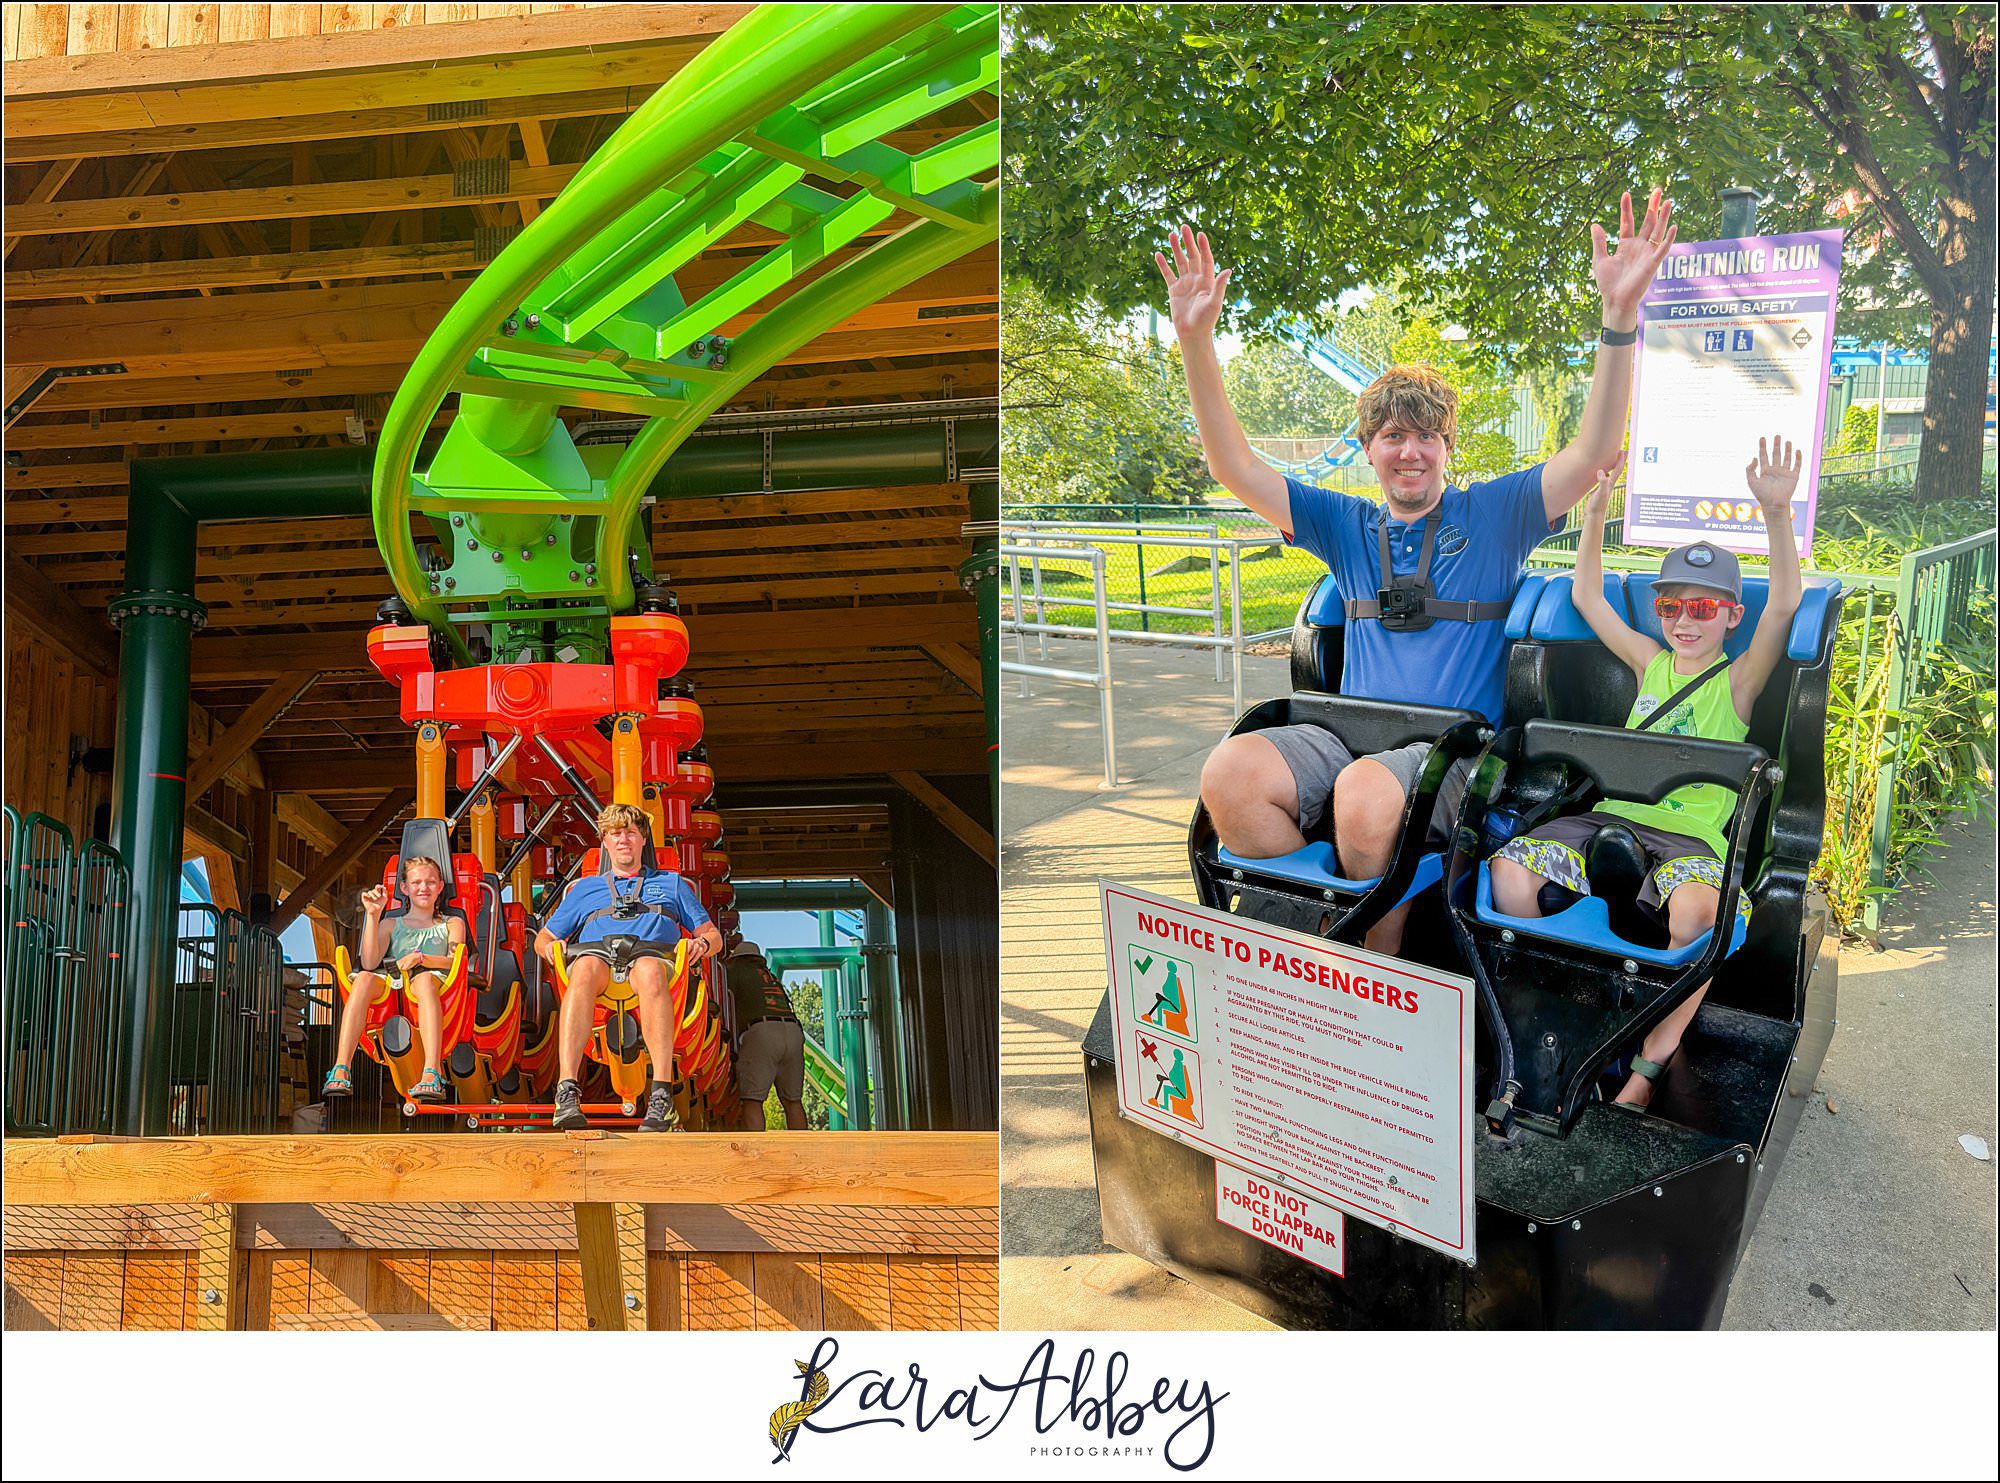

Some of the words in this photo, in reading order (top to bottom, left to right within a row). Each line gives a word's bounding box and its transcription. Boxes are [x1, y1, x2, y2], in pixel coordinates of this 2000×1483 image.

[1656, 248, 1766, 281] LIGHTNING
[1771, 244, 1820, 272] RUN
[1670, 306, 1697, 317] FOR
[1700, 303, 1738, 315] YOUR
[1741, 300, 1798, 313] SAFETY
[1138, 911, 1215, 953] NOTICE
[1221, 936, 1251, 963] TO
[1259, 947, 1419, 1014] PASSENGERS
[1226, 974, 1234, 982] NO
[1235, 977, 1247, 986] ONE
[1248, 981, 1267, 992] UNDER
[1276, 990, 1296, 1001] INCHES
[1297, 996, 1304, 1004] IN
[1305, 999, 1327, 1011] HEIGHT
[1328, 1006, 1341, 1016] MAY
[1343, 1011, 1359, 1021] RIDE.
[1227, 997, 1262, 1014] AGGRAVATED
[1272, 1012, 1284, 1021] THIS
[1285, 1016, 1300, 1026] RIDE,
[1301, 1021, 1314, 1031] YOU
[1315, 1026, 1331, 1036] MUST
[1332, 1032, 1345, 1041] NOT
[1347, 1036, 1362, 1047] RIDE.
[1228, 1011, 1247, 1023] SECURE
[1249, 1019, 1258, 1027] ALL
[1259, 1022, 1277, 1034] LOOSE
[1278, 1029, 1305, 1043] ARTICLES.
[1233, 991, 1244, 1000] YOU
[1245, 995, 1255, 1003] ARE
[1256, 999, 1286, 1014] PREGNANT
[1287, 1009, 1296, 1017] OR
[1297, 1012, 1312, 1022] HAVE
[1319, 1019, 1353, 1036] CONDITION
[1355, 1031, 1370, 1041] THAT
[1372, 1036, 1393, 1049] COULD
[1395, 1044, 1403, 1052] BE
[1229, 1027, 1241, 1036] KEEP
[1242, 1031, 1263, 1044] HANDS,
[1264, 1039, 1281, 1050] ARMS,
[1282, 1045, 1295, 1055] AND
[1296, 1050, 1308, 1060] FEET
[1309, 1055, 1329, 1067] INSIDE
[1330, 1062, 1341, 1071] THE
[1342, 1066, 1356, 1077] RIDE
[1357, 1072, 1382, 1086] VEHICLE
[1383, 1081, 1403, 1093] WHILE
[1405, 1088, 1429, 1103] RIDING.
[1230, 1049, 1255, 1063] ALCOHOL
[1256, 1058, 1266, 1067] ARE
[1267, 1062, 1279, 1072] NOT
[1280, 1067, 1311, 1084] PERMITTED
[1313, 1079, 1320, 1087] TO
[1322, 1082, 1336, 1093] RIDE.
[1230, 1042, 1253, 1055] PERSONS
[1255, 1050, 1268, 1060] WHO
[1269, 1056, 1280, 1065] ARE
[1281, 1060, 1301, 1072] VISIBLY
[1302, 1067, 1310, 1076] ILL
[1312, 1071, 1320, 1079] OR
[1322, 1074, 1342, 1087] UNDER
[1343, 1082, 1354, 1091] THE
[1356, 1087, 1389, 1104] INFLUENCE
[1391, 1099, 1399, 1108] OF
[1401, 1103, 1422, 1116] DRUGS
[1424, 1111, 1433, 1120] OR
[1231, 1070, 1239, 1078] TO
[1240, 1074, 1254, 1084] RIDE.
[1231, 1063, 1255, 1077] PERSONS
[1256, 1073, 1269, 1083] WHO
[1271, 1078, 1293, 1092] CANNOT
[1295, 1087, 1302, 1095] BE
[1303, 1090, 1332, 1106] PROPERLY
[1333, 1101, 1369, 1120] RESTRAINED
[1370, 1115, 1382, 1125] ARE
[1383, 1120, 1396, 1130] NOT
[1398, 1125, 1433, 1144] PERMITTED
[1232, 1085, 1240, 1093] TO
[1241, 1088, 1253, 1098] RIDE
[1254, 1093, 1265, 1103] YOU
[1267, 1098, 1283, 1110] MUST:
[1234, 1098, 1248, 1108] HAVE
[1249, 1104, 1261, 1113] TWO
[1263, 1109, 1287, 1123] NATURAL
[1288, 1119, 1327, 1139] FUNCTIONING
[1329, 1134, 1342, 1145] LEGS
[1344, 1140, 1356, 1151] AND
[1358, 1146, 1370, 1156] ONE
[1372, 1151, 1415, 1174] FUNCTIONING
[1416, 1169, 1436, 1182] HAND.
[1235, 1109, 1243, 1117] SIT
[1244, 1113, 1267, 1127] UPRIGHT
[1268, 1123, 1282, 1133] WITH
[1283, 1129, 1298, 1140] YOUR
[1300, 1135, 1314, 1146] BACK
[1315, 1141, 1340, 1156] AGAINST
[1341, 1152, 1352, 1161] THE
[1354, 1157, 1385, 1175] BACKREST.
[1235, 1121, 1261, 1136] POSITION
[1262, 1132, 1272, 1141] THE
[1273, 1136, 1283, 1145] LAP
[1284, 1141, 1295, 1150] BAR
[1296, 1146, 1316, 1159] FIRMLY
[1317, 1154, 1342, 1169] AGAINST
[1343, 1164, 1360, 1177] YOUR
[1361, 1172, 1384, 1187] THIGHS.
[1386, 1182, 1405, 1195] THERE
[1406, 1190, 1419, 1201] CAN
[1421, 1196, 1429, 1205] BE
[1236, 1129, 1245, 1137] NO
[1246, 1133, 1262, 1144] SPACE
[1263, 1140, 1288, 1155] BETWEEN
[1289, 1150, 1299, 1159] THE
[1300, 1155, 1310, 1164] LAP
[1311, 1159, 1323, 1169] BAR
[1324, 1164, 1337, 1175] AND
[1338, 1170, 1354, 1182] YOUR
[1356, 1177, 1379, 1193] THIGHS.
[1236, 1140, 1256, 1153] FASTEN
[1257, 1149, 1267, 1158] THE
[1268, 1154, 1293, 1169] SEATBELT
[1294, 1164, 1307, 1174] AND
[1308, 1170, 1321, 1181] PULL
[1329, 1179, 1352, 1193] SNUGLY
[1353, 1189, 1379, 1205] AROUND
[1381, 1200, 1396, 1212] YOU.
[1247, 1179, 1271, 1200] DO
[1274, 1190, 1309, 1217] NOT
[1223, 1186, 1270, 1219] FORCE
[1273, 1207, 1336, 1249] LAPBAR
[1252, 1217, 1304, 1252] DOWN
